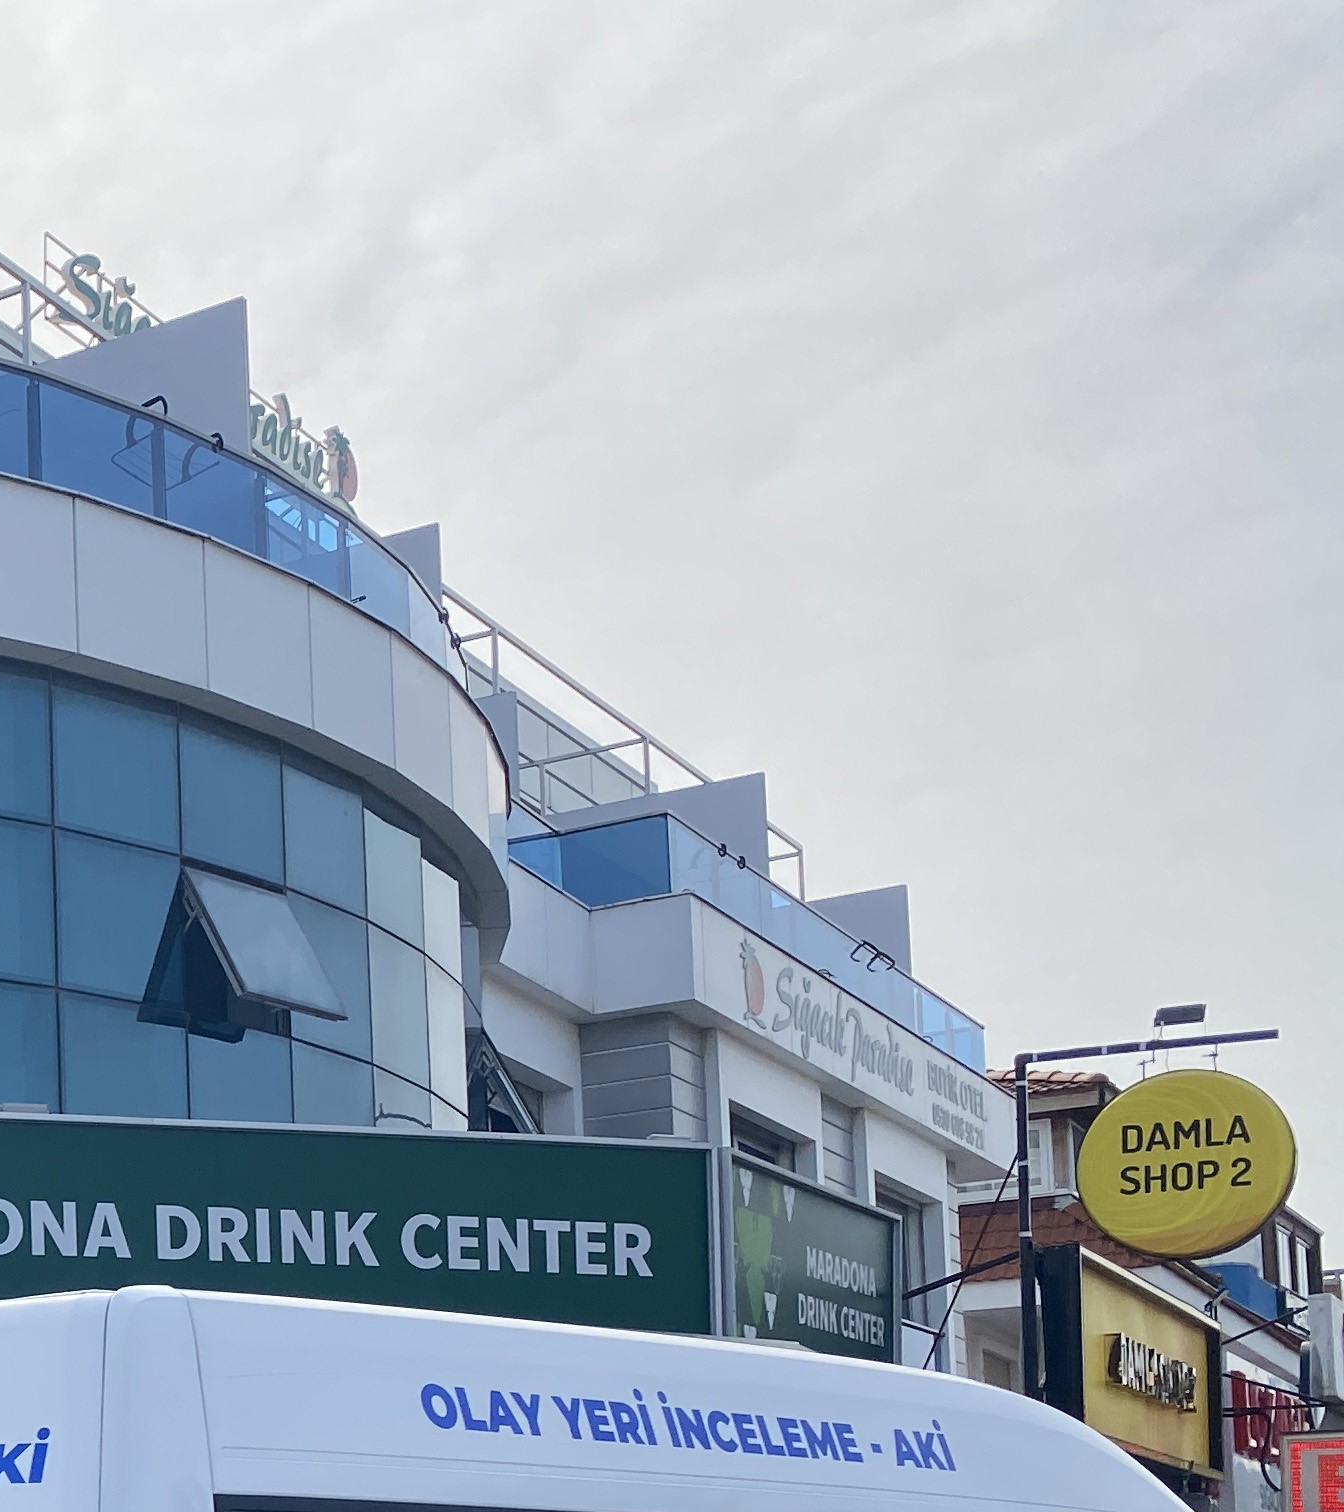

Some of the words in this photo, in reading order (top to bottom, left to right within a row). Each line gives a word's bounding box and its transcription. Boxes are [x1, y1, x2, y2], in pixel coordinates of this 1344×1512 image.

[1120, 1114, 1251, 1155] DAMLA
[1119, 1159, 1222, 1196] SHOP
[1230, 1158, 1253, 1187] 2
[156, 1204, 382, 1267] DRINK
[400, 1212, 655, 1279] CENTER
[806, 1245, 877, 1298] MARADONA
[797, 1292, 839, 1335] DRINK
[840, 1306, 885, 1348] CENTER
[420, 1382, 543, 1438] OLAY
[550, 1387, 658, 1447] YERİ
[656, 1390, 865, 1464] İNCELEME
[893, 1418, 958, 1473] AKİ
